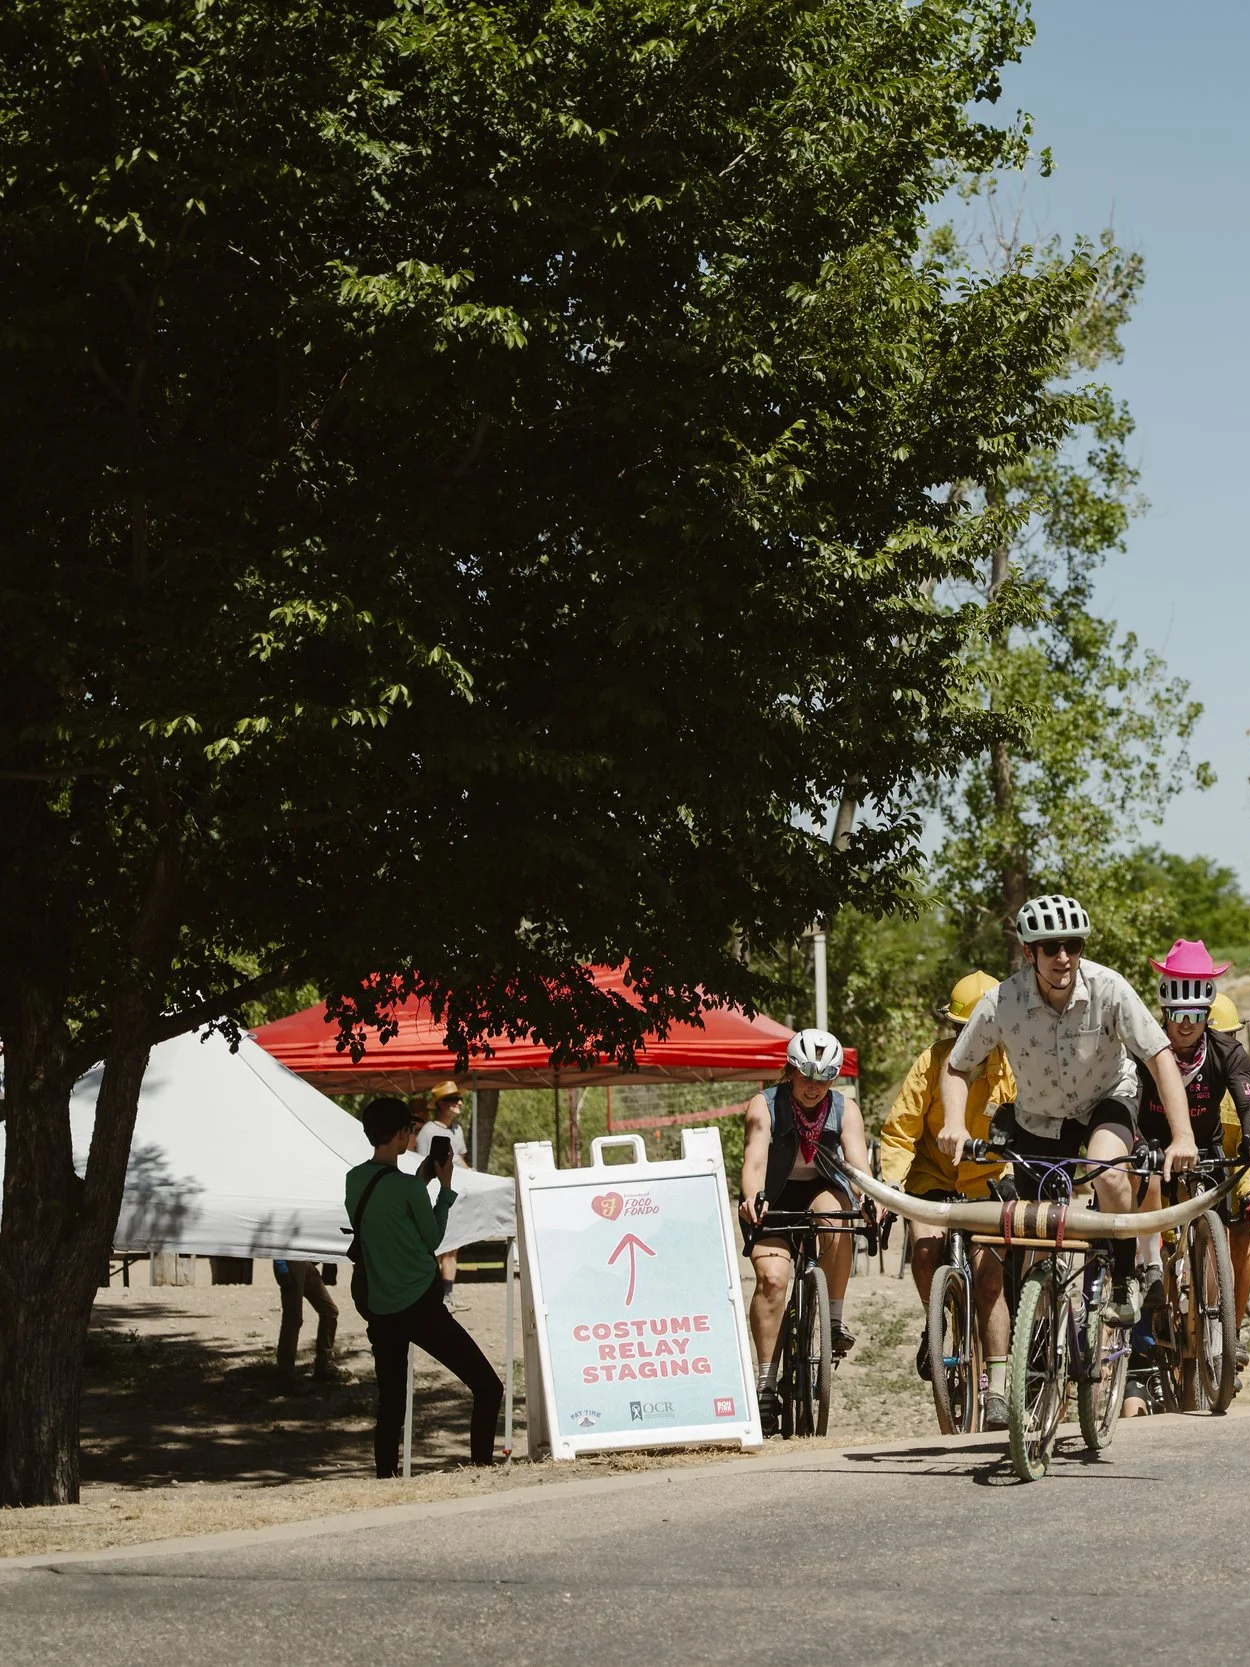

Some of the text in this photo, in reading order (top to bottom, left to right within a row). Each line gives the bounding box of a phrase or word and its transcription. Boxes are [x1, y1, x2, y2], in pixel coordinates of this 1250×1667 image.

[624, 1197, 652, 1208] FOCO
[623, 1205, 660, 1216] FONDO
[573, 1315, 711, 1342] COSTUME
[598, 1338, 690, 1360] RELAY
[582, 1357, 712, 1383] STAGING
[584, 1409, 602, 1418] TIRE
[643, 1401, 675, 1414] OCR
